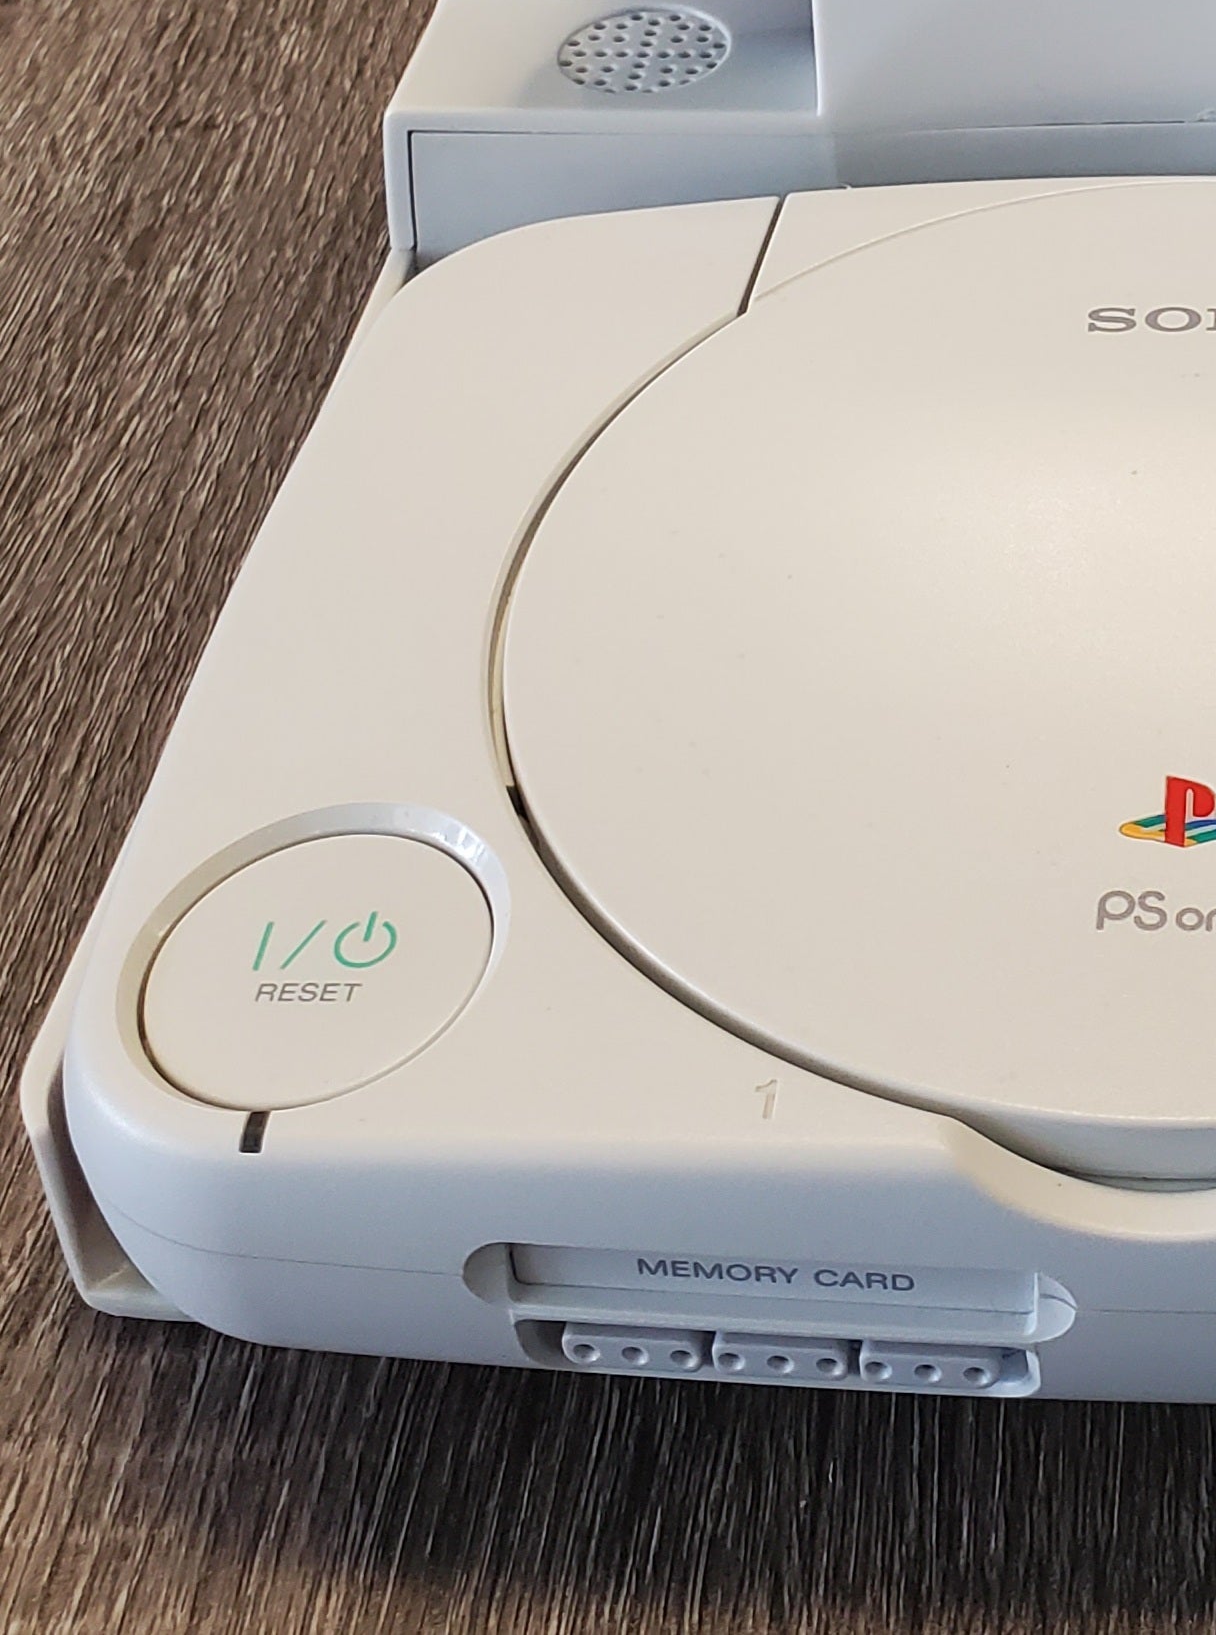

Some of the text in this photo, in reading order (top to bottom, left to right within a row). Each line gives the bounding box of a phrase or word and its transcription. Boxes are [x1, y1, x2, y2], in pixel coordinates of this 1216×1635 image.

[1095, 889, 1168, 932] PS
[255, 983, 363, 1002] RESET
[754, 1078, 779, 1120] 1
[636, 1257, 916, 1292] MEMORY CARD
